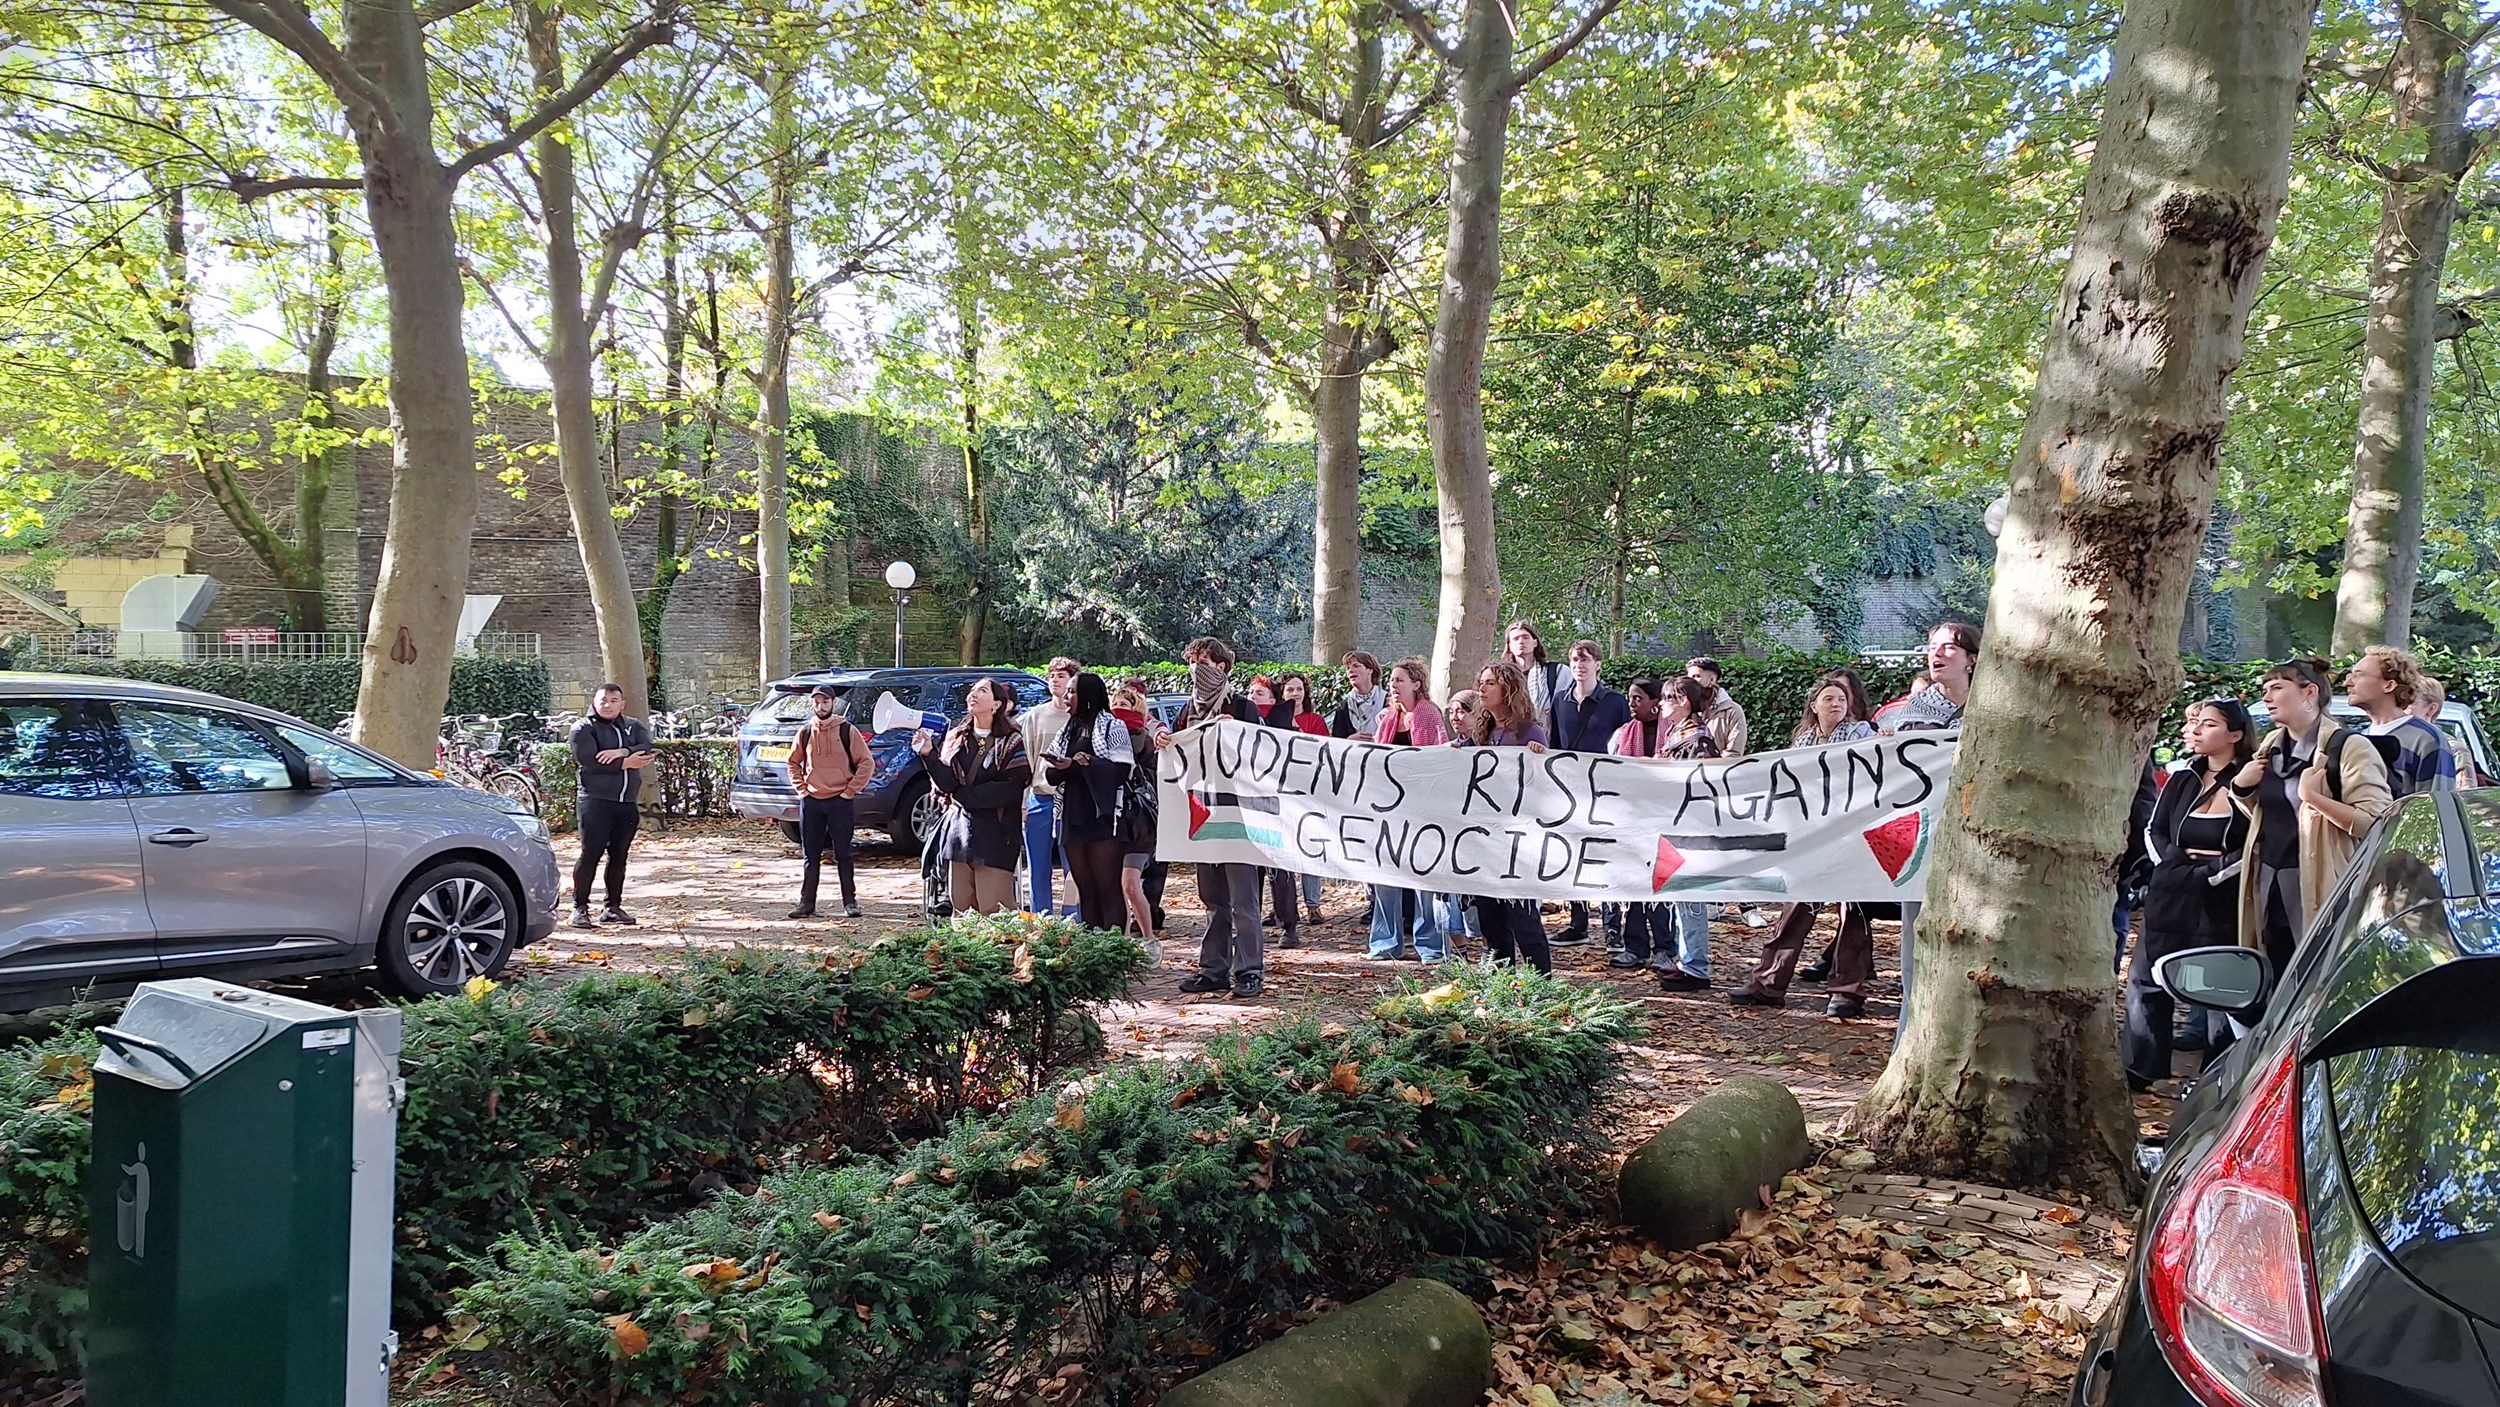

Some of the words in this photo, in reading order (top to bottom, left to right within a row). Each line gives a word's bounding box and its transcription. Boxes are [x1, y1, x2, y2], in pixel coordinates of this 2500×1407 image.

[1461, 749, 1624, 828] RISE
[1672, 736, 1958, 827] AGAINS
[1296, 811, 1617, 889] GENOCIDE
